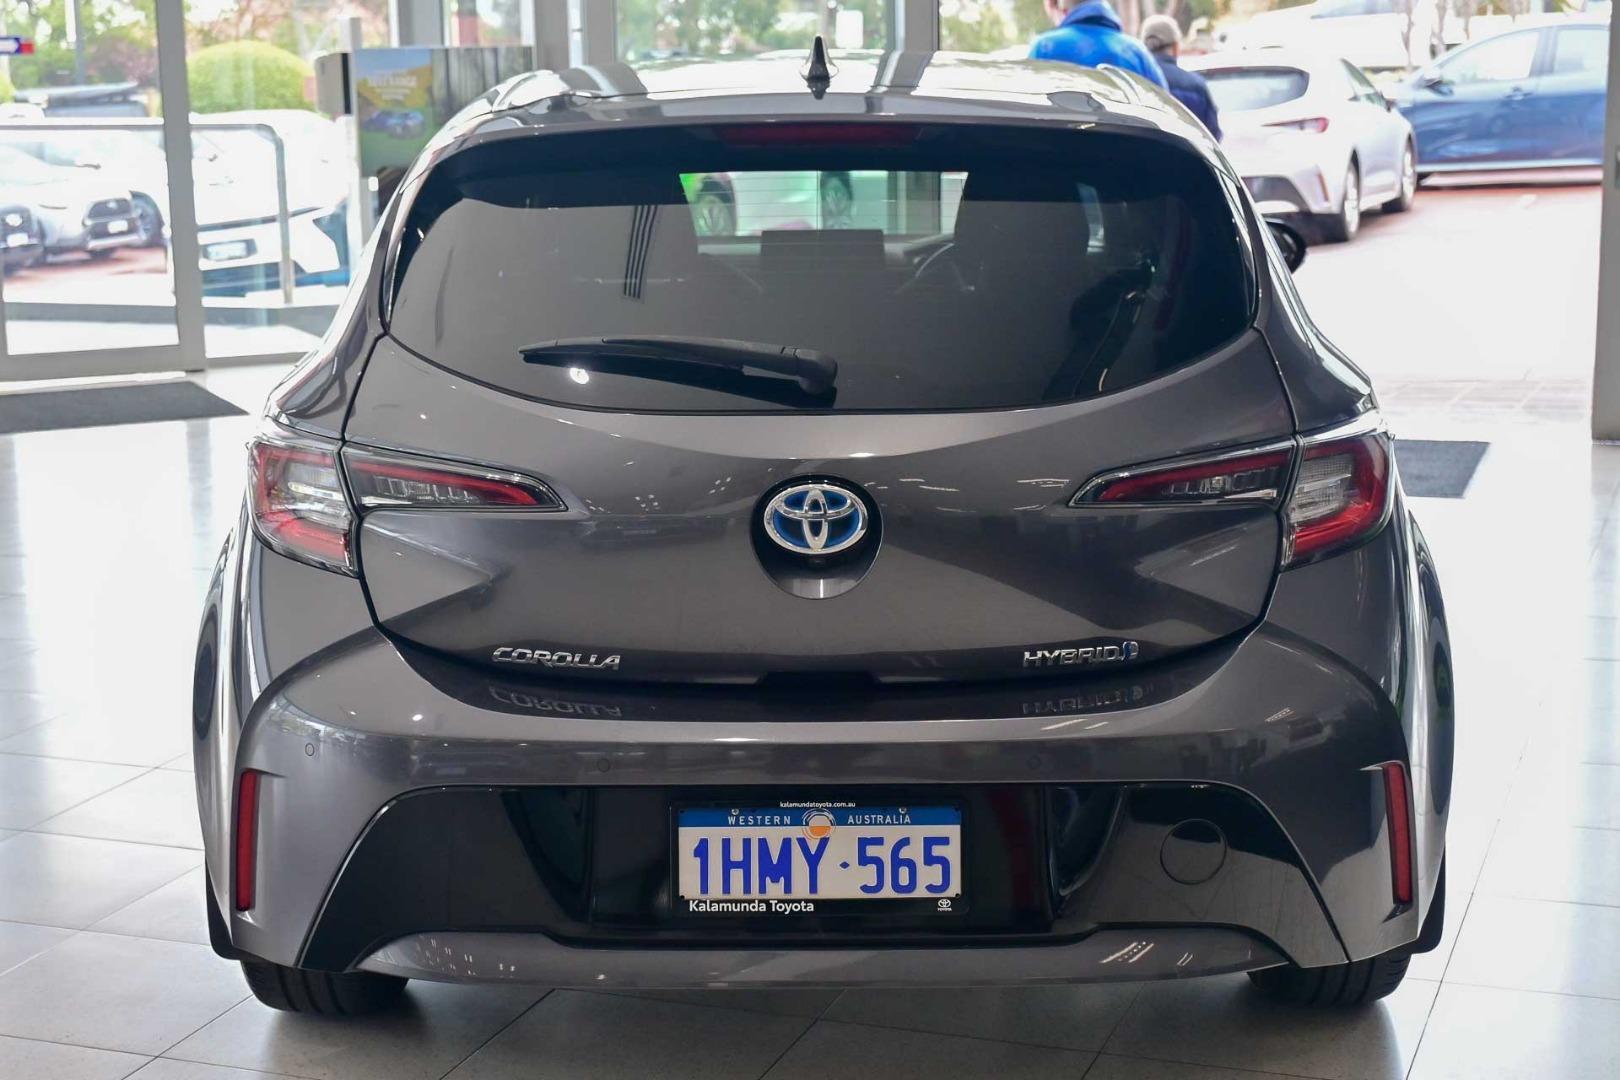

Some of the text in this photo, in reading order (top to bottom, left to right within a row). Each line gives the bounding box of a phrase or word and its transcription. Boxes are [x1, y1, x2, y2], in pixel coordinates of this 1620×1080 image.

[492, 646, 622, 671] COROLLA
[1022, 645, 1121, 668] HYBRID
[779, 801, 856, 809] kalamundatoyota.com.au
[727, 814, 912, 826] WESTERN AUSTRALIA
[689, 900, 815, 915] Kalamunda Toyota
